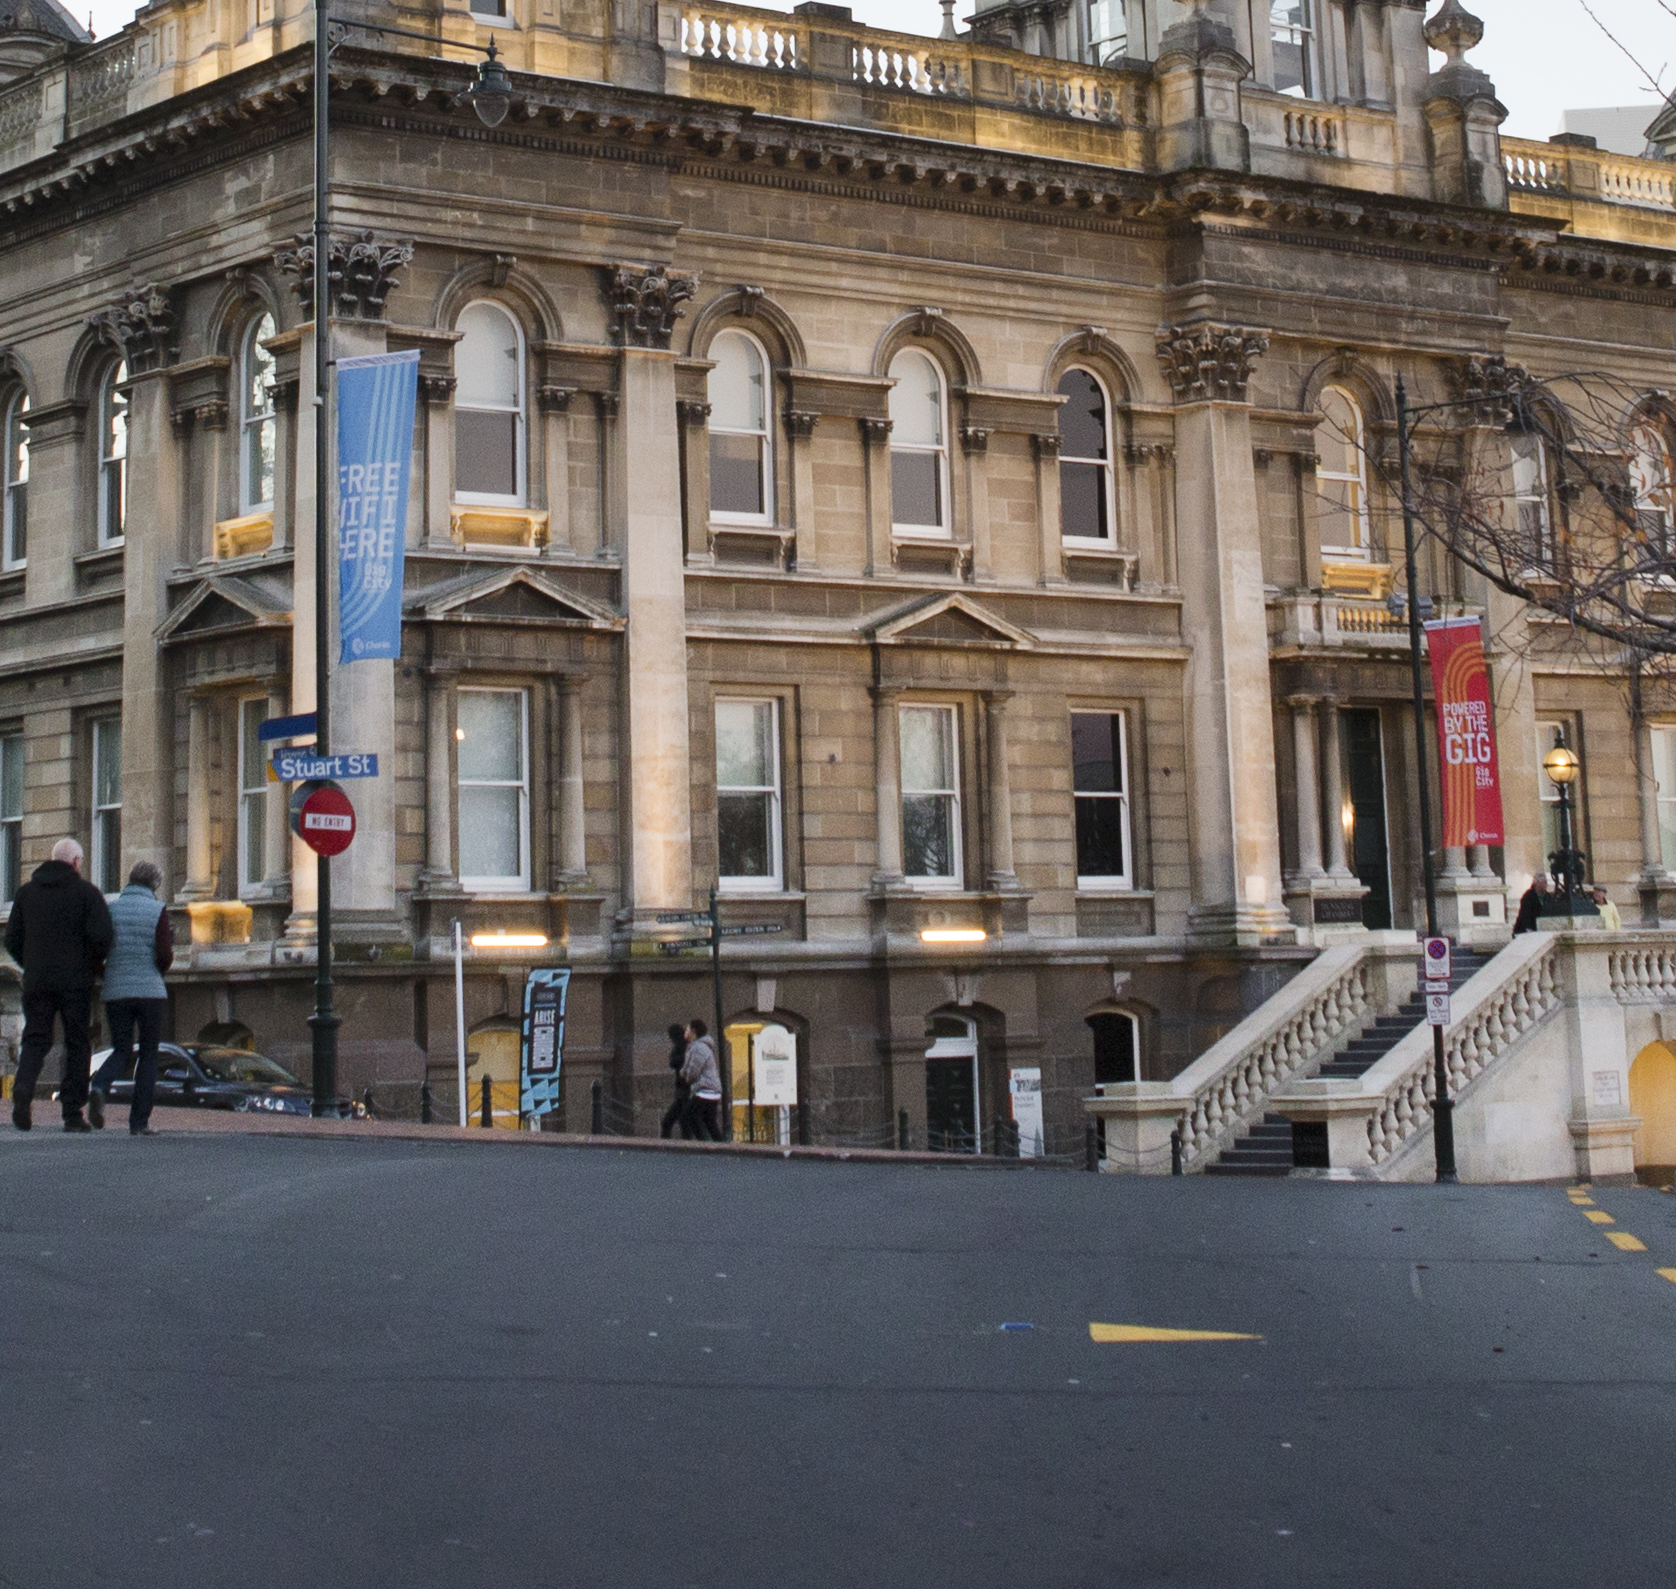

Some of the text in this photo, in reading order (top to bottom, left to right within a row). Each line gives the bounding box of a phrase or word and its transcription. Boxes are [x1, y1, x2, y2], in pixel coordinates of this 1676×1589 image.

[1442, 701, 1486, 716] POWERED
[1444, 715, 1488, 734] BY THE
[1446, 732, 1491, 765] GIG
[281, 755, 371, 779] Stuart St
[312, 817, 345, 828] NO ENTRY
[534, 1010, 556, 1025] ARISE
